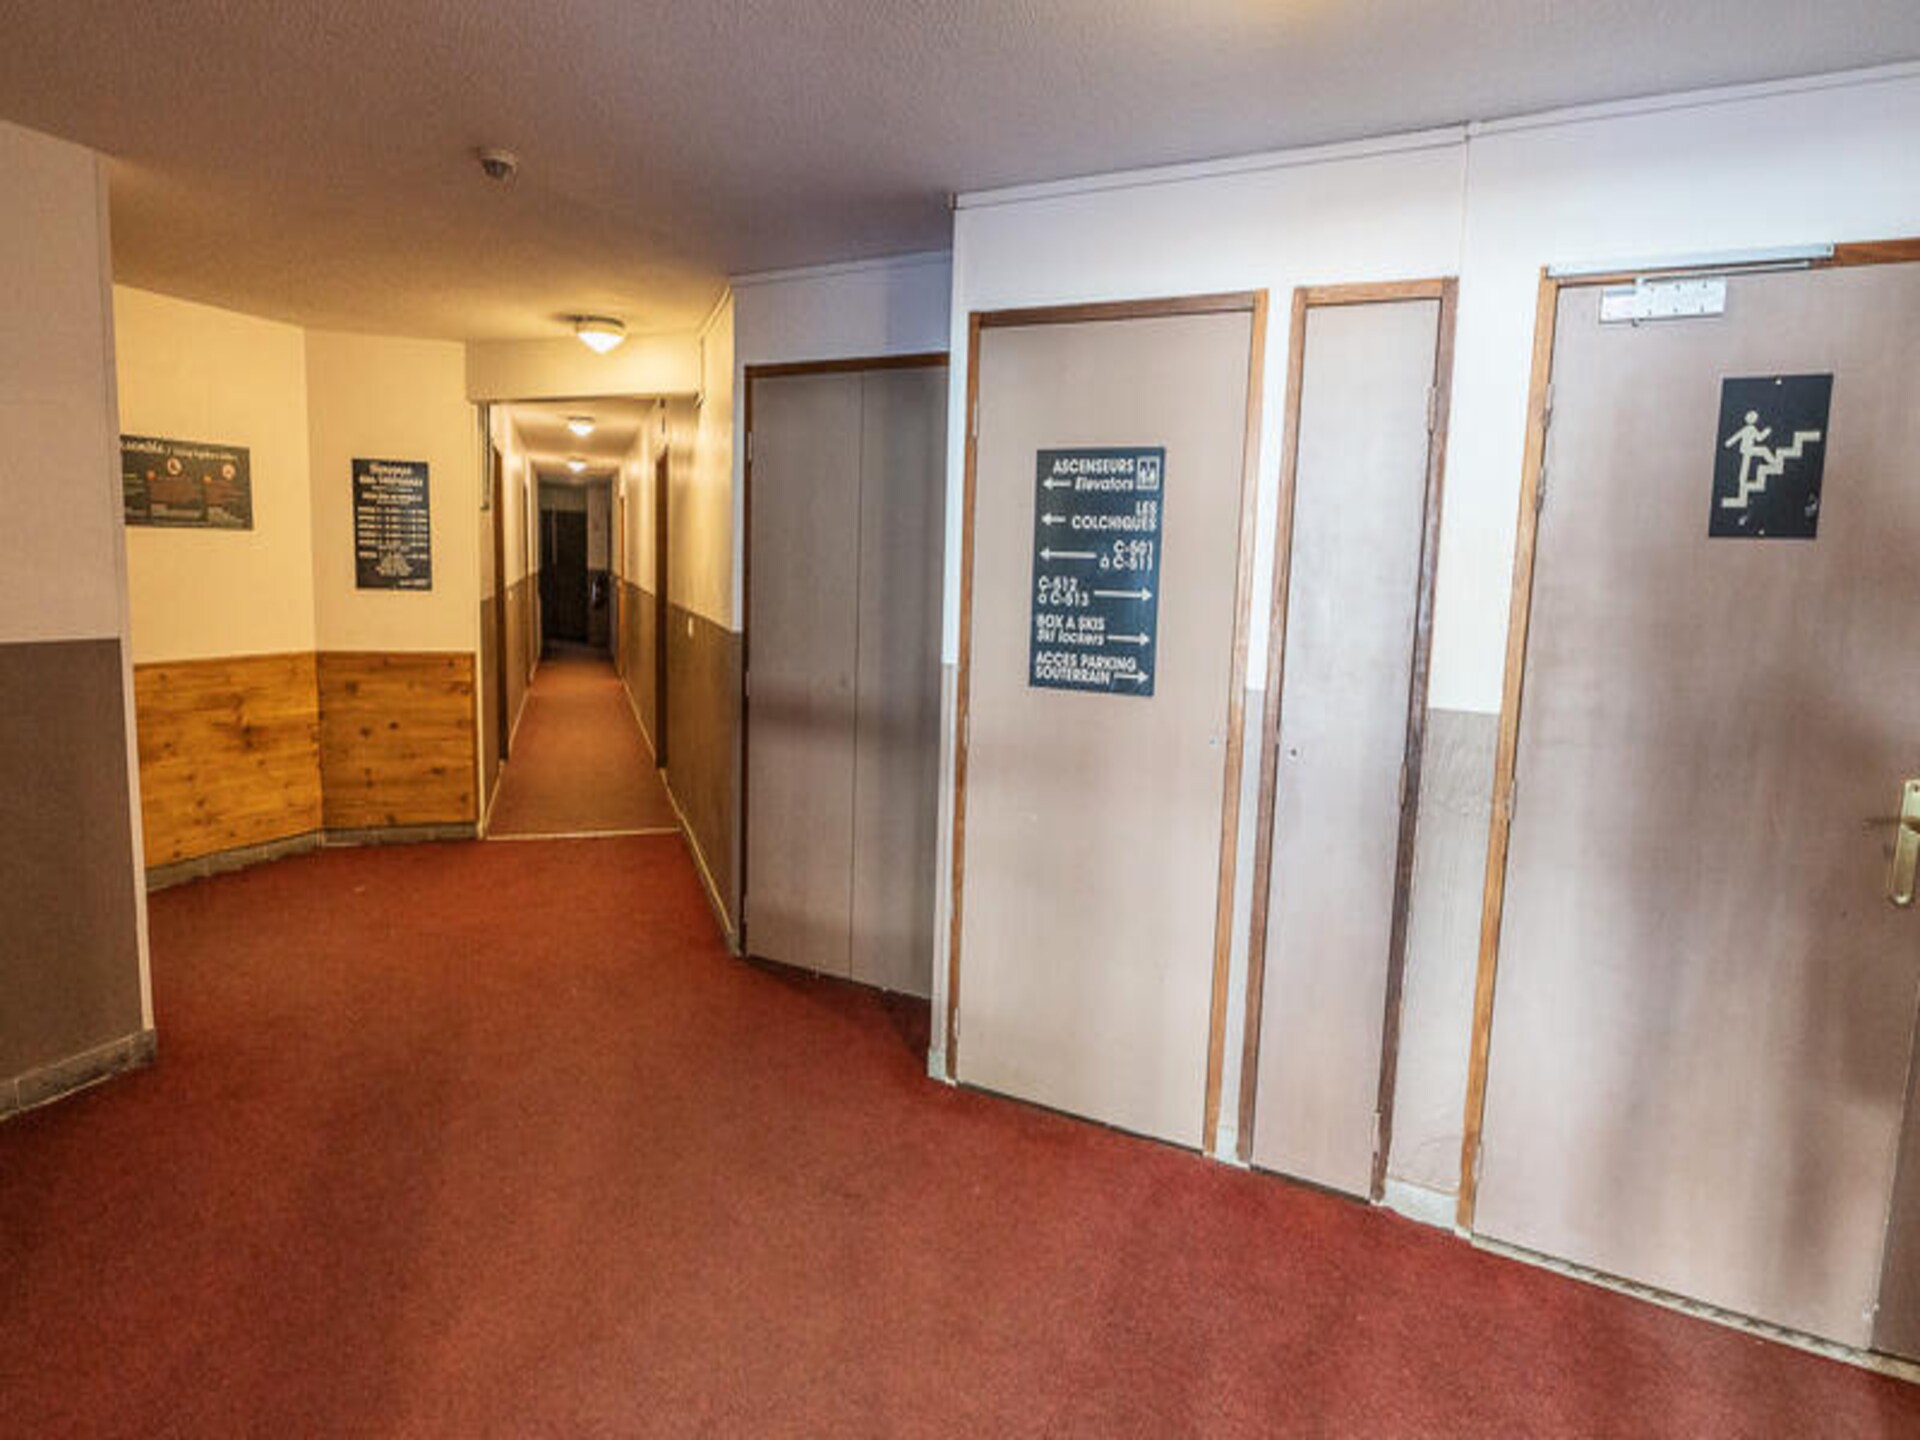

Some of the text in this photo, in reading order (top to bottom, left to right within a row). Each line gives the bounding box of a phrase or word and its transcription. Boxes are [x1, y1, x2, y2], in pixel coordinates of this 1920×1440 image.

[1053, 458, 1134, 474] ASCENSEURS
[1075, 476, 1134, 491] Elevators
[1135, 501, 1157, 516] LES
[1072, 515, 1157, 532] COLCHIQUES
[1036, 614, 1064, 629] BOX
[1078, 617, 1105, 631] SKIS
[1080, 654, 1137, 672] PARKING
[1036, 665, 1110, 685] SOUTERRAIN
